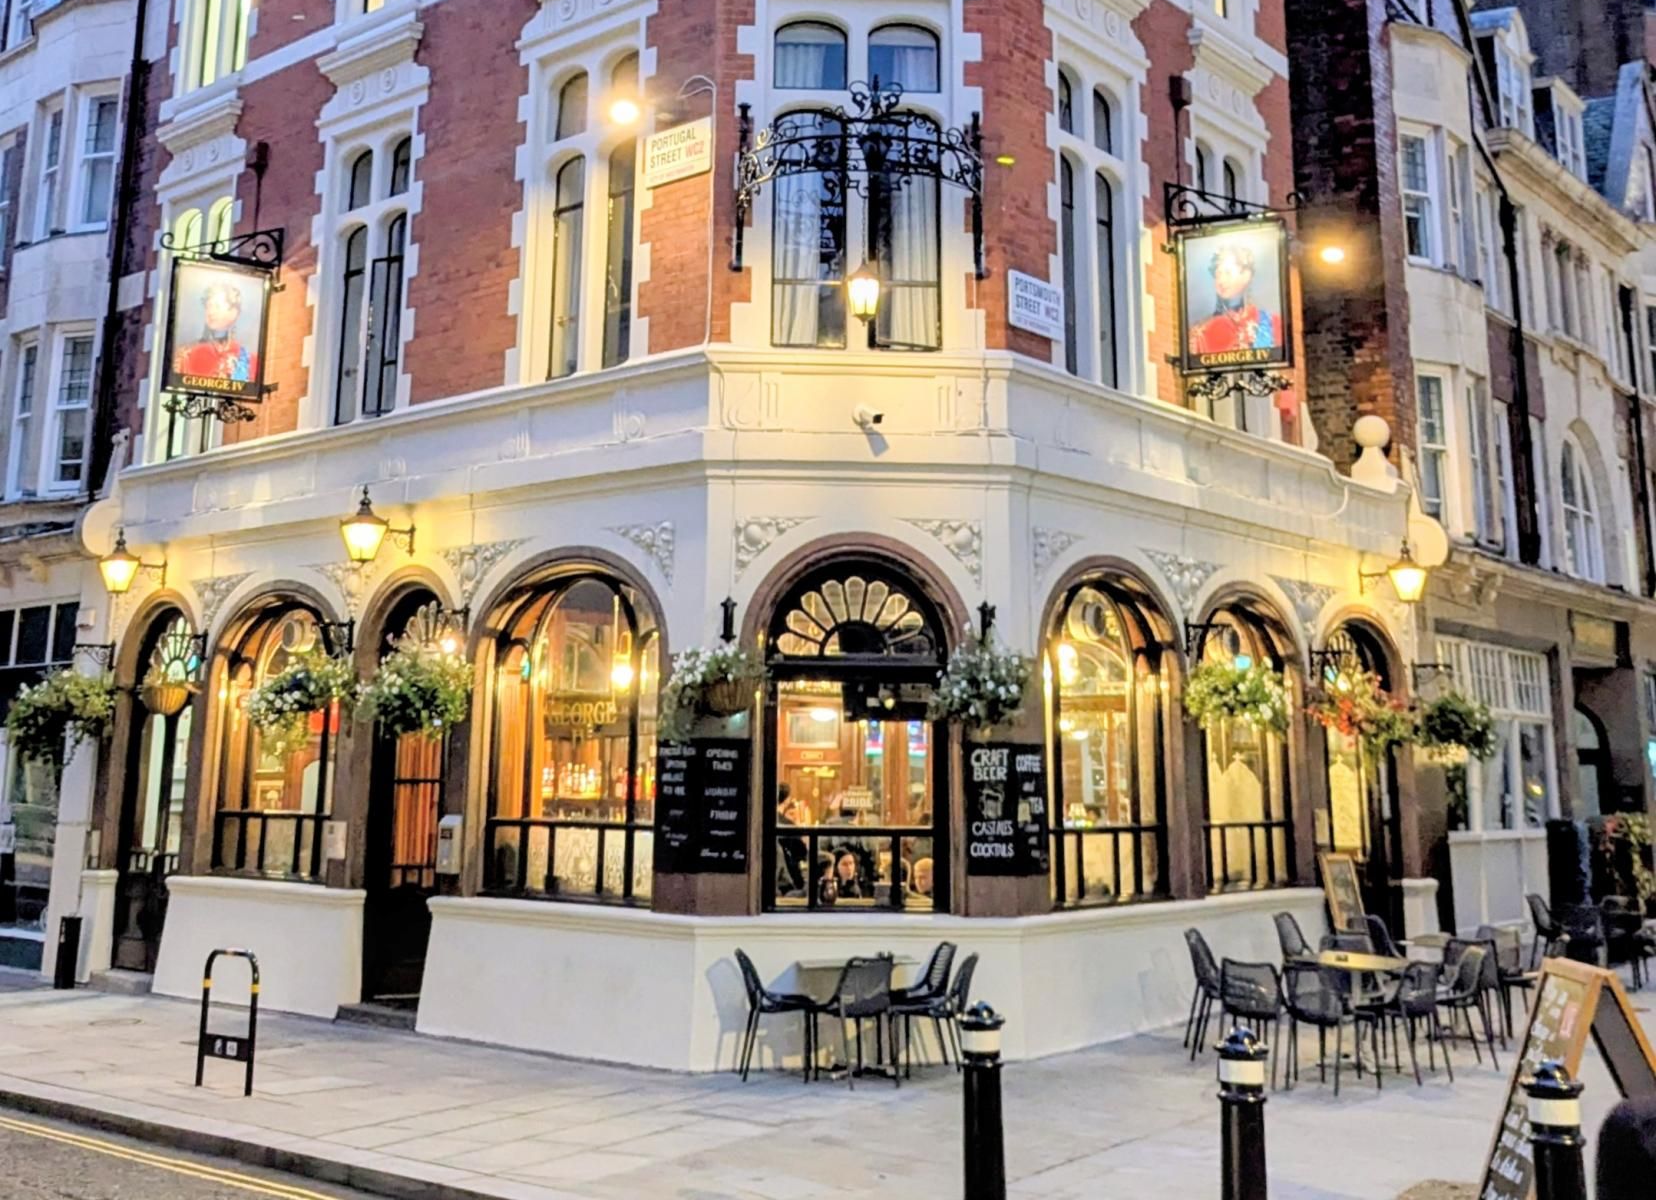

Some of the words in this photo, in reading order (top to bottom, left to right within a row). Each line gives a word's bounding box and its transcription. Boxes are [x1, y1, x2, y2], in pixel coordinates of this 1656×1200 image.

[651, 127, 697, 153] PORTUGAL
[650, 147, 682, 169] STREET
[1015, 294, 1041, 315] STREET
[1200, 349, 1254, 366] GEORGE
[1256, 348, 1271, 361] IV
[182, 375, 230, 390] GEORGE
[231, 380, 246, 392] IV
[970, 748, 1009, 767] CRAFT
[973, 766, 1008, 781] BEER
[970, 842, 1015, 858] COCKTAILS
